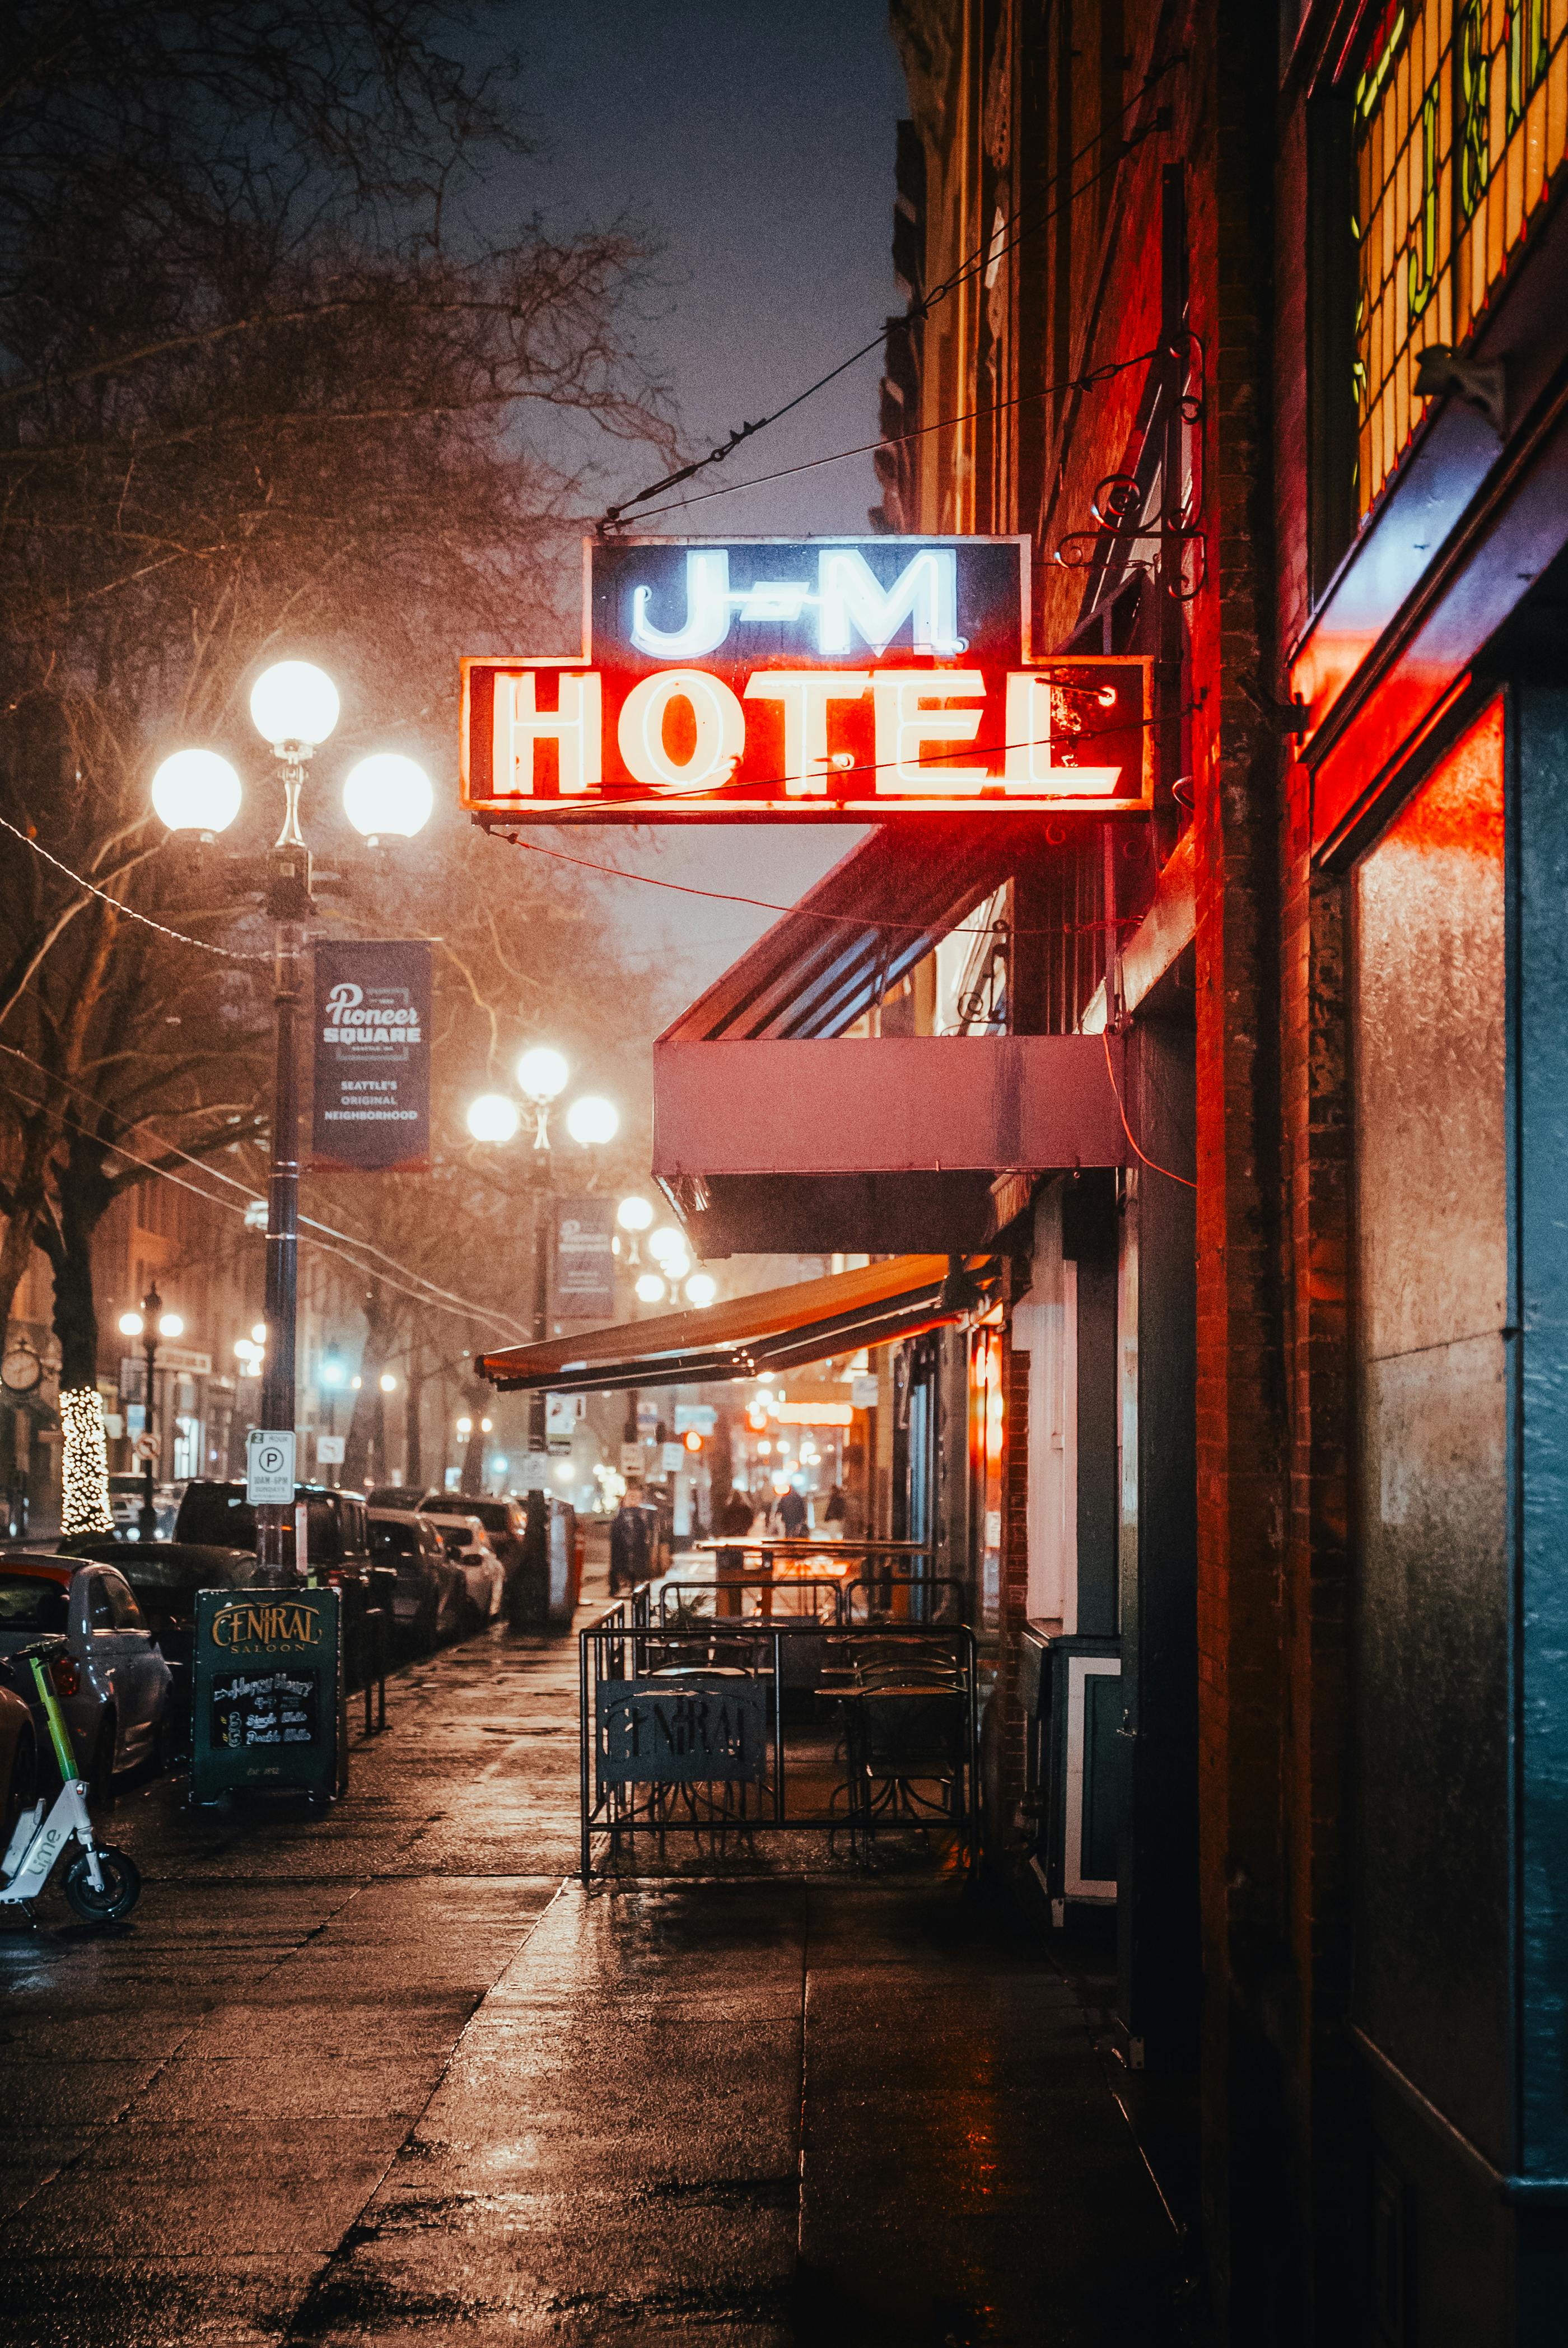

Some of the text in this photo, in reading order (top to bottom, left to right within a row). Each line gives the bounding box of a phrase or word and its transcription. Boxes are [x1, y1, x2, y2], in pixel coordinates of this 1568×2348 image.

[629, 549, 959, 659] J-M
[492, 669, 1122, 796] HOTEL
[325, 983, 419, 1026] Pioneer
[323, 1028, 421, 1045] SQUARE
[340, 1080, 398, 1091] SEATTLE'S
[340, 1096, 398, 1106] ORIGINAL
[324, 1110, 418, 1121] NEIGHBORHOOD
[267, 1453, 278, 1467] P
[212, 1602, 323, 1647] CENTRAL
[230, 1644, 306, 1653] SALOON
[26, 1829, 63, 1875] Lime
